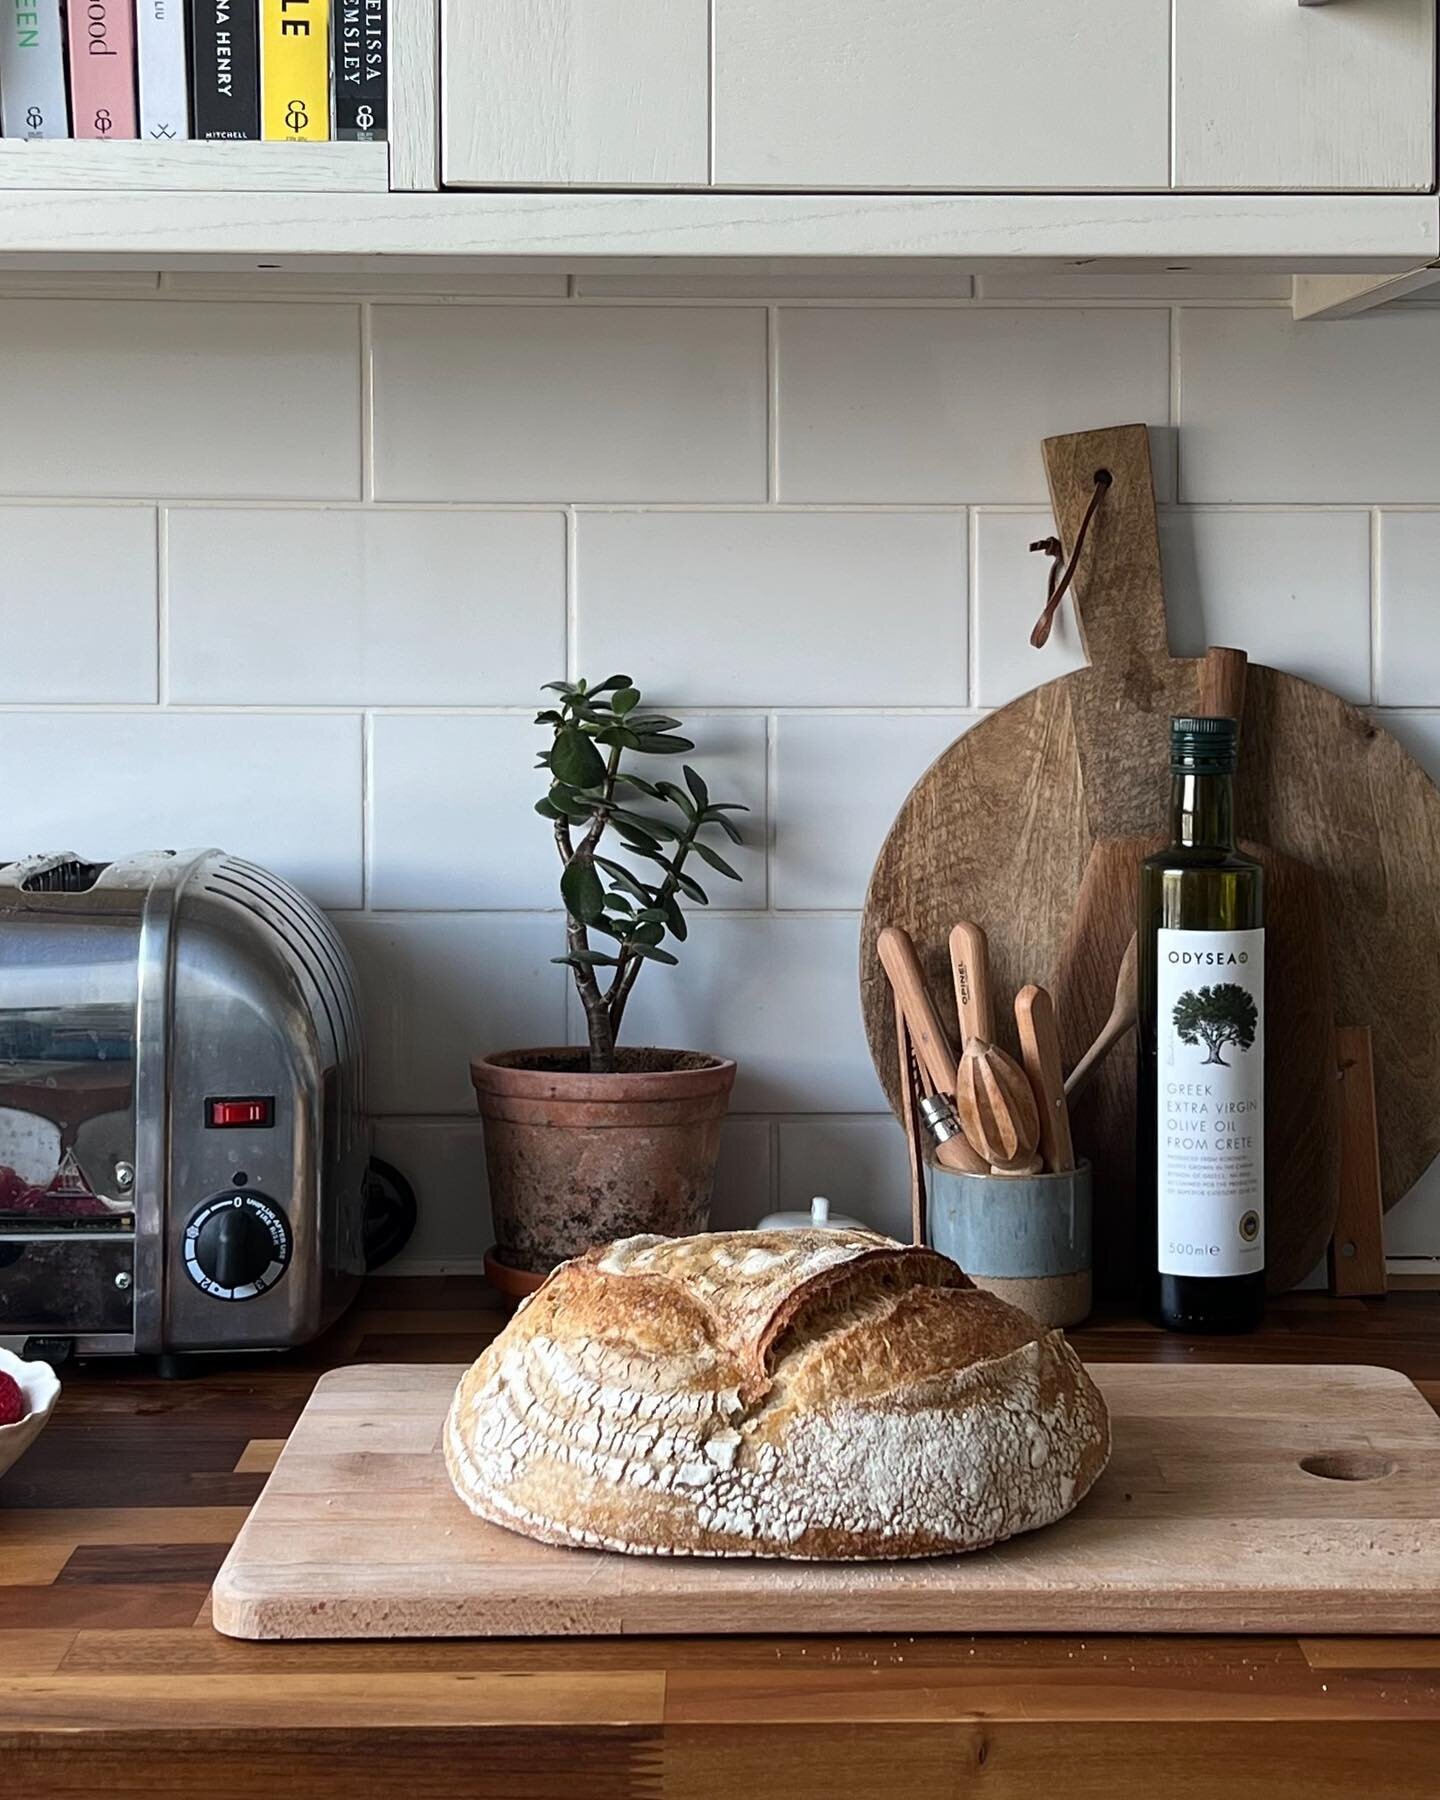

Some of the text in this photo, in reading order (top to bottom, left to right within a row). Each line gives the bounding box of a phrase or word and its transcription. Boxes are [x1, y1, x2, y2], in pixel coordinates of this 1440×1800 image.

[154, 1, 165, 20] LIU
[281, 0, 310, 36] LE
[88, 0, 118, 55] ood
[365, 0, 382, 80] ELISSA
[216, 32, 232, 97] HENRY
[205, 131, 248, 139] MITCHELL
[958, 960, 968, 1006] OPINEL
[1167, 1083, 1213, 1097] GREEK
[1167, 1099, 1257, 1114] EXTRA VIRGIN
[1167, 1118, 1236, 1133] OLIVE OIL
[1167, 1137, 1254, 1150] FROM CRETE
[233, 1197, 242, 1208] 0
